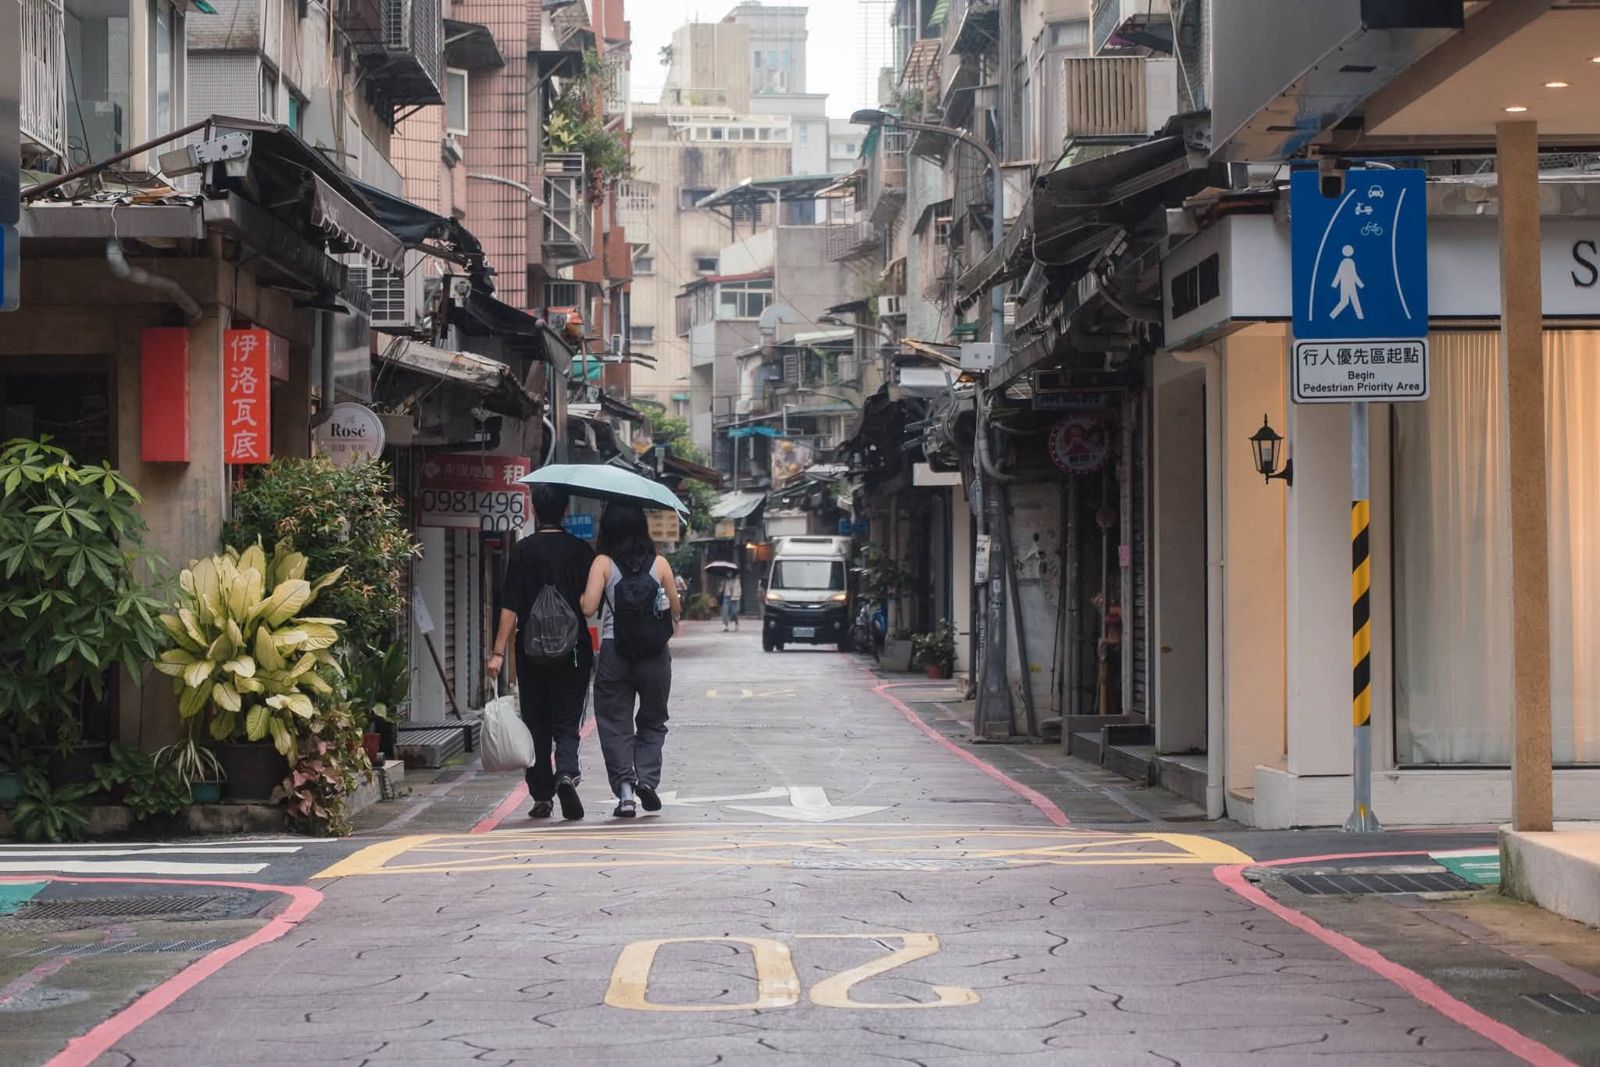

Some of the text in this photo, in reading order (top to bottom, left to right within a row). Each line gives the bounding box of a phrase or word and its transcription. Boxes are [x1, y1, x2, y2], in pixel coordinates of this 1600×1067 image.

[1571, 240, 1598, 288] S
[1302, 346, 1420, 366] 行人優先區起點
[1348, 370, 1375, 382] Begin
[230, 334, 259, 459] 伊洛瓦底
[1303, 381, 1420, 393] Pedestrian Priority Area
[331, 423, 366, 438] Rosé
[503, 464, 525, 485] 租
[421, 490, 524, 514] 0981496
[480, 514, 524, 531] 008
